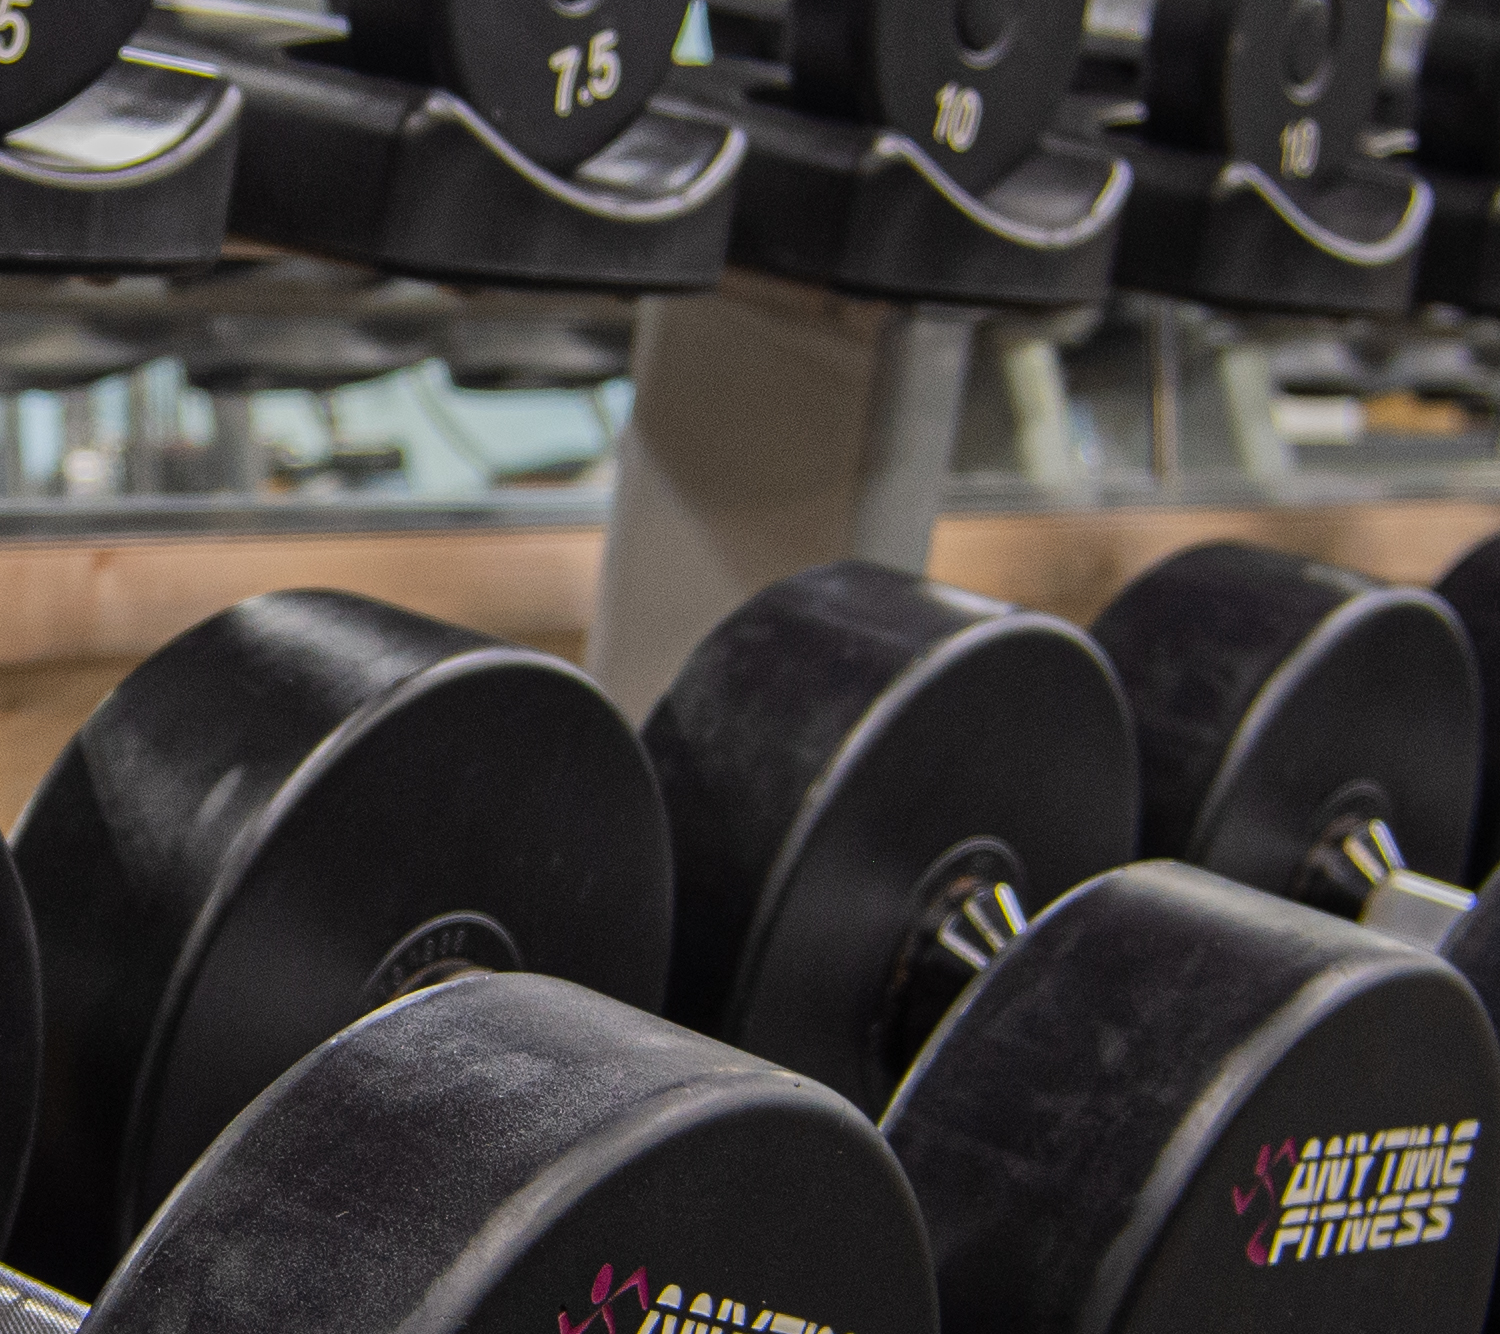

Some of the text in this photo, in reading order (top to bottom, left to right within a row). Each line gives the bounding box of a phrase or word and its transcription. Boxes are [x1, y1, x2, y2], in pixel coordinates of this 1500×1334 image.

[548, 29, 622, 117] 7.5
[934, 82, 982, 152] 10
[1280, 1118, 1482, 1208] ANYTIME
[1267, 1187, 1461, 1267] FITNESS
